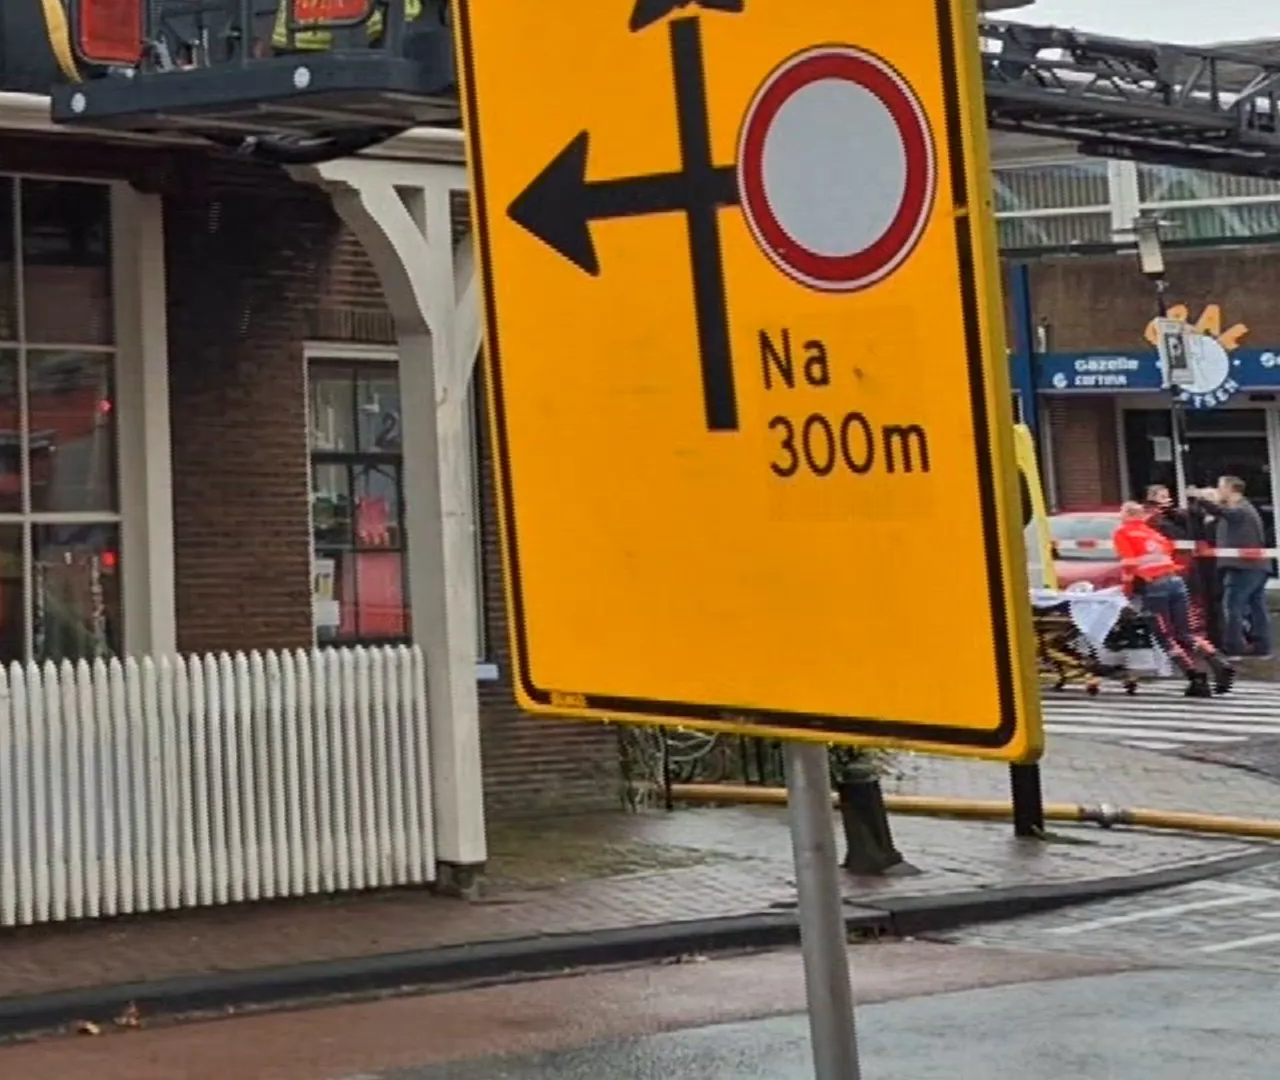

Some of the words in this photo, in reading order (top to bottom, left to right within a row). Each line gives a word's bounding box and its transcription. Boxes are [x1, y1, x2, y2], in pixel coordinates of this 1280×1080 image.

[758, 328, 831, 390] Na
[1074, 357, 1139, 372] Gazelle
[768, 412, 930, 477] 300m
